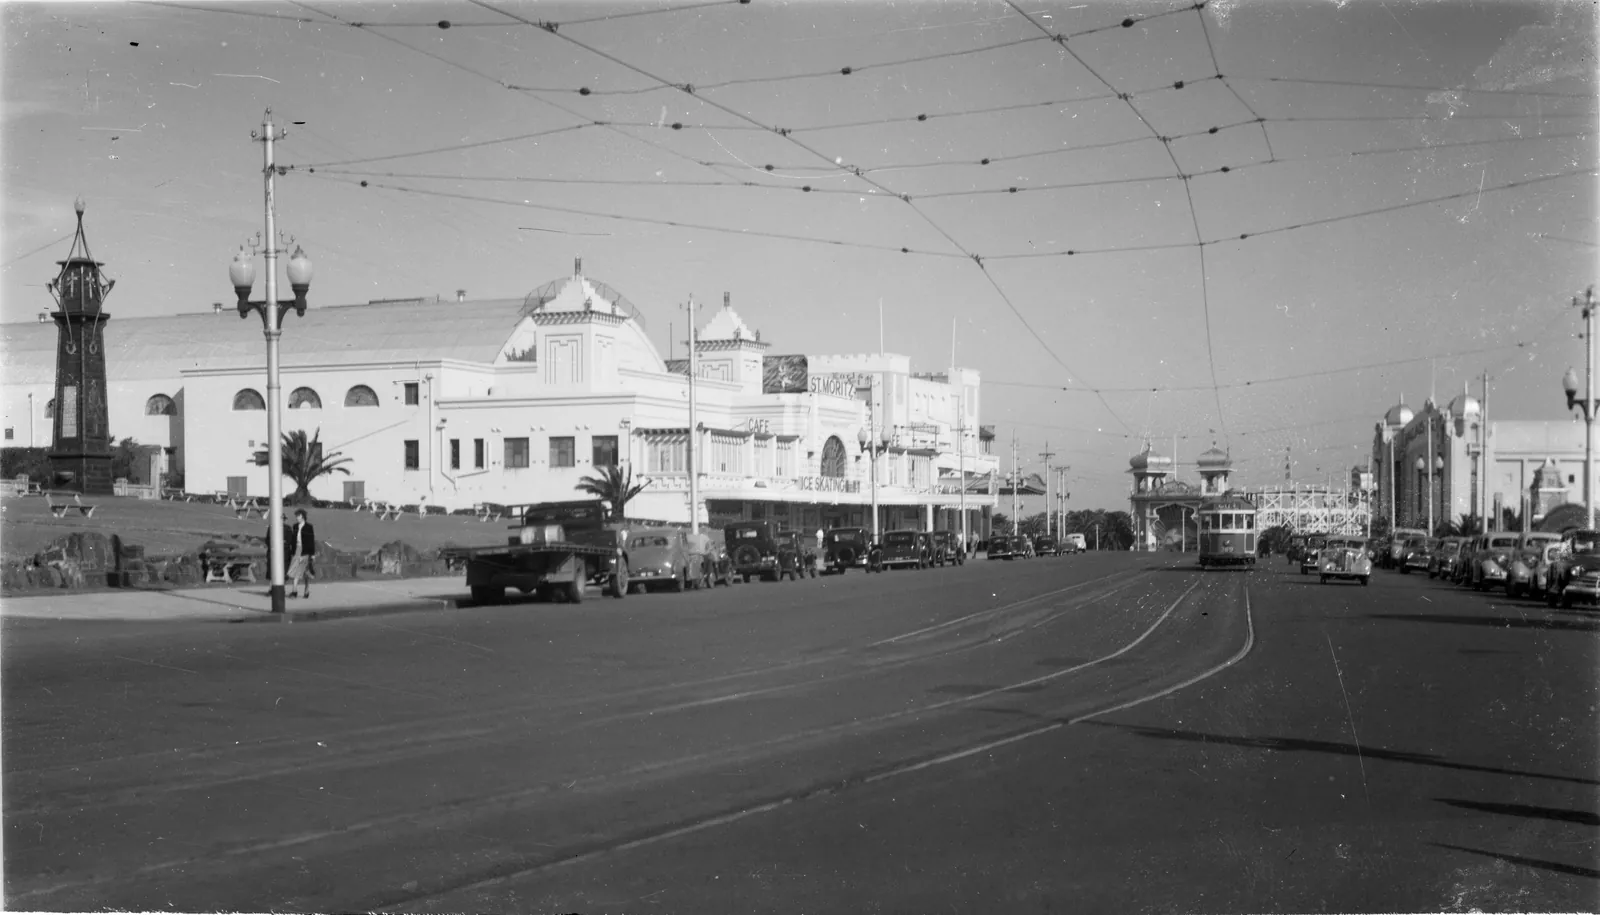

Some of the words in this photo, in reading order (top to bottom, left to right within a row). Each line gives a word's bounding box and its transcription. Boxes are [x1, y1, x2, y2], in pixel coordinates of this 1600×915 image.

[748, 418, 769, 434] CAFE
[801, 476, 813, 491] ICE
[815, 476, 845, 492] SKATING
